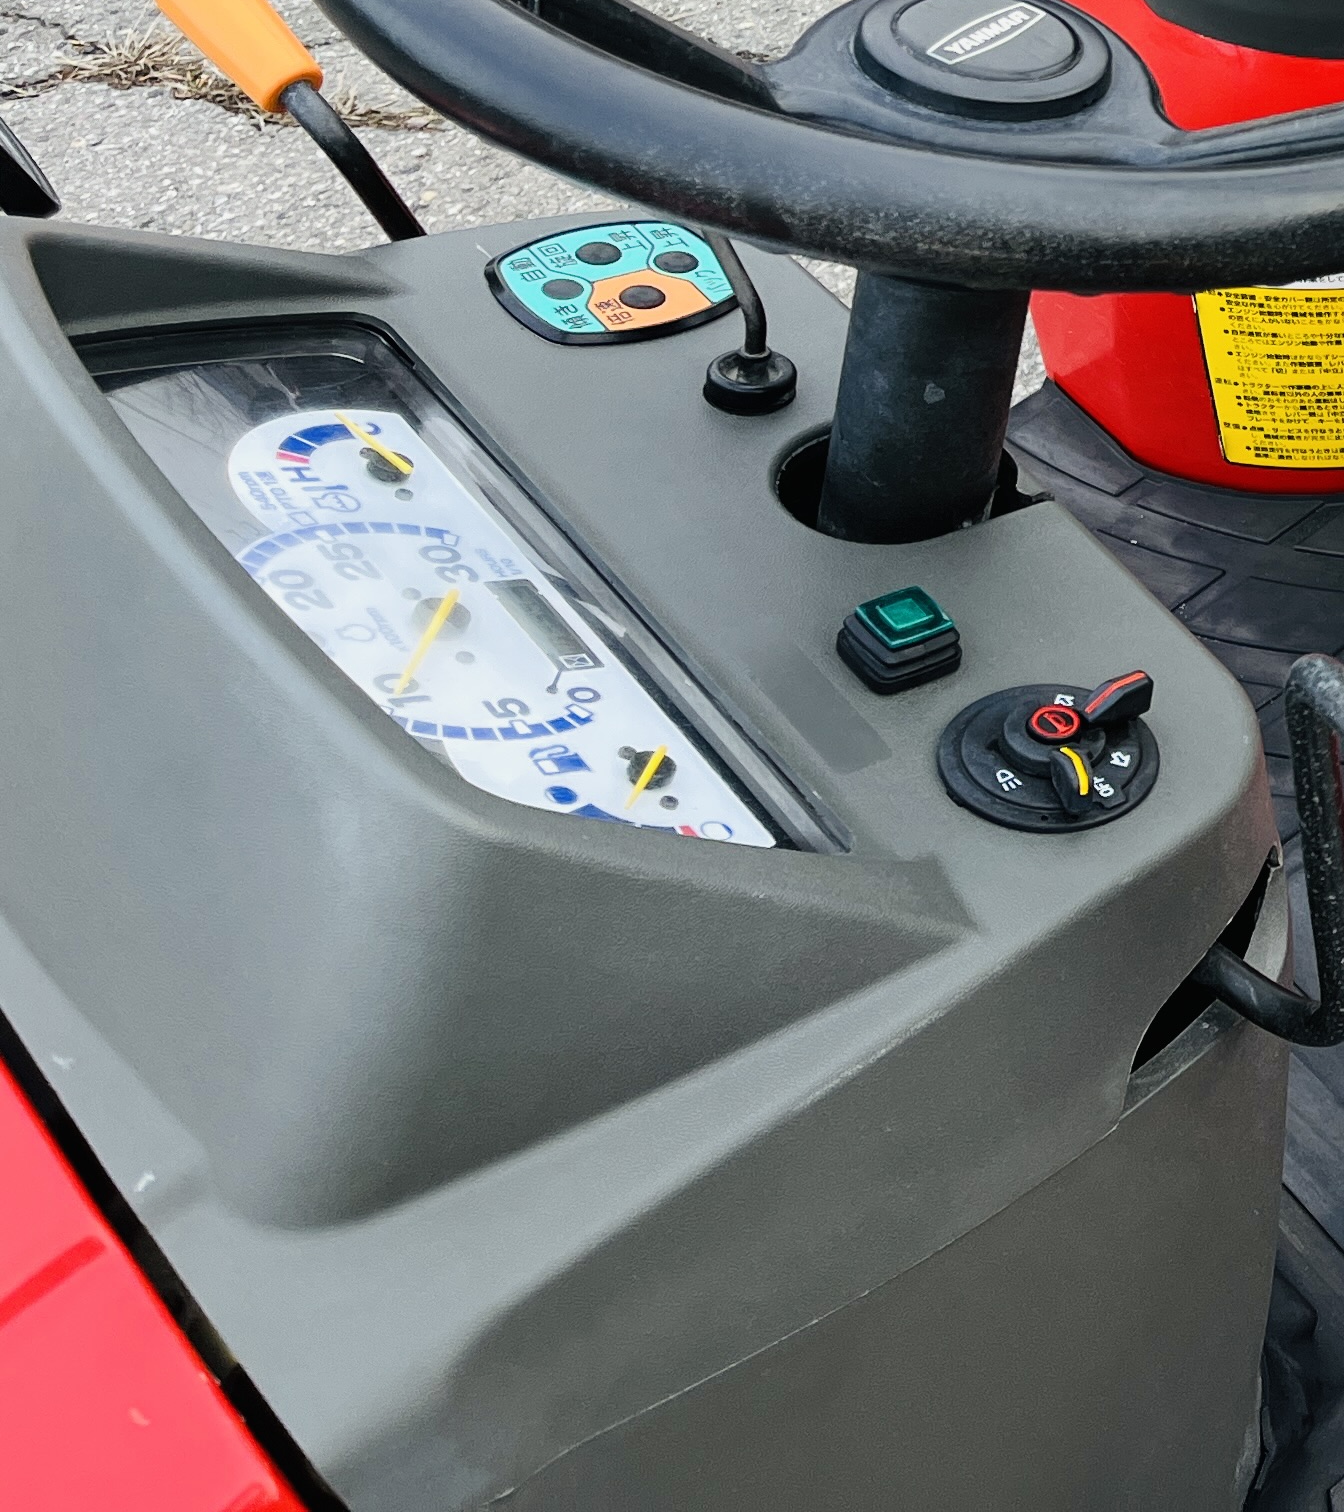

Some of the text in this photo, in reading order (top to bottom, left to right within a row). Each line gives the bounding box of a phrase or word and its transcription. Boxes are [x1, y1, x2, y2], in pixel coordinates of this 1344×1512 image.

[943, 10, 1030, 55] YANMAR
[608, 229, 648, 250] 上昇
[652, 227, 690, 248] 上昇
[537, 243, 578, 268] 旋回
[508, 256, 547, 282] 自動
[554, 303, 592, 330] 傾き
[315, 543, 383, 581] 25
[418, 544, 480, 584] 30
[268, 568, 336, 610] 20
[482, 697, 531, 719] 5
[566, 687, 601, 704] 0
[1092, 776, 1115, 798] OFF
